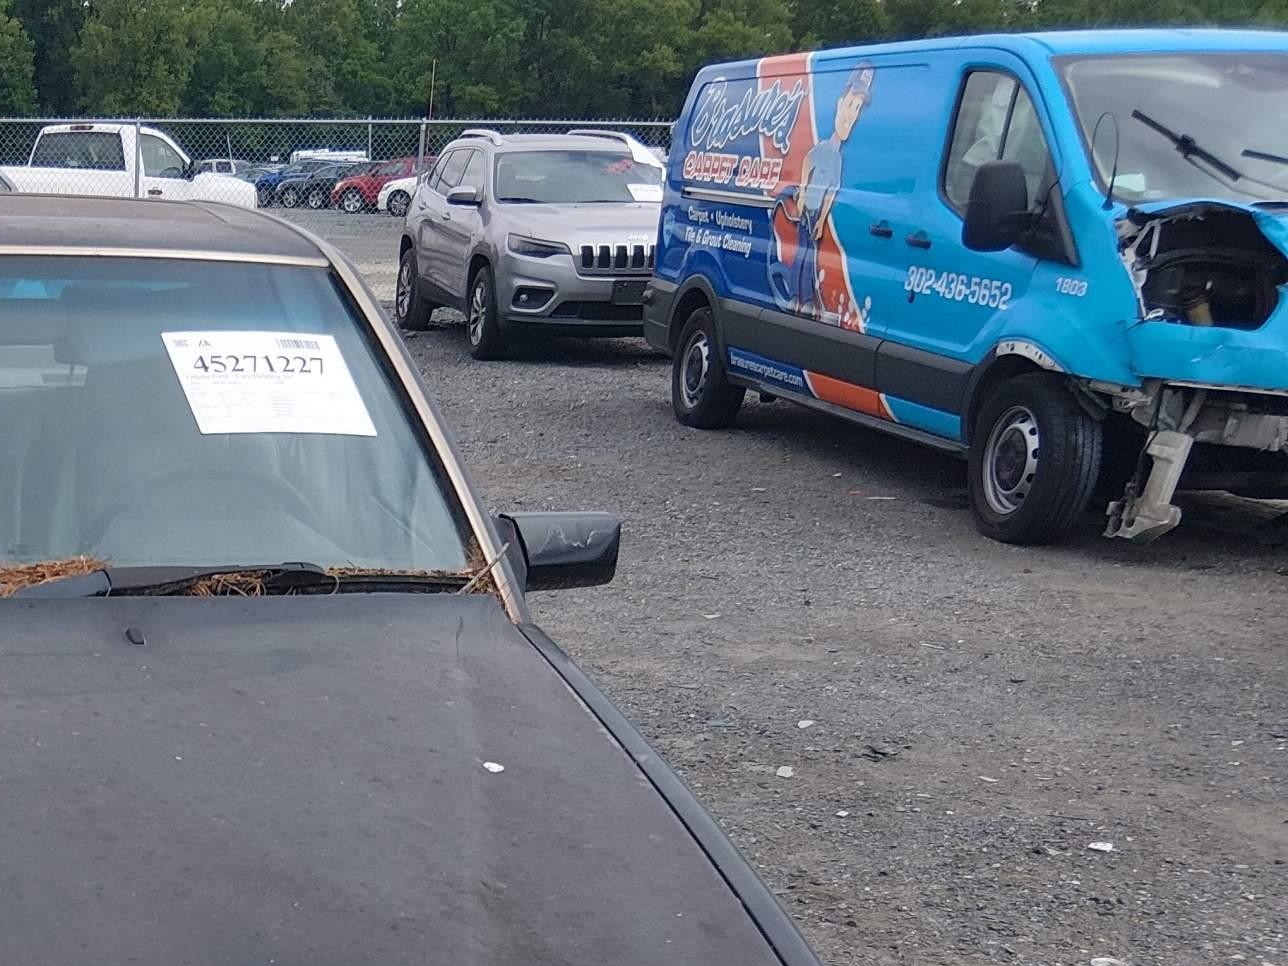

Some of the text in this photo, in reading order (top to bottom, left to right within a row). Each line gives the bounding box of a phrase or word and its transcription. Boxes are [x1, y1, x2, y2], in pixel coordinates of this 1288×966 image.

[683, 151, 783, 189] CARPET CARE
[688, 205, 753, 235] Carpet Upholstery
[684, 226, 697, 242] Tile
[702, 230, 722, 248] Grout
[722, 233, 752, 258] Cleaning
[904, 266, 1012, 310] 302-436-5652
[1055, 277, 1088, 297] 1803
[194, 355, 324, 375] 45271227
